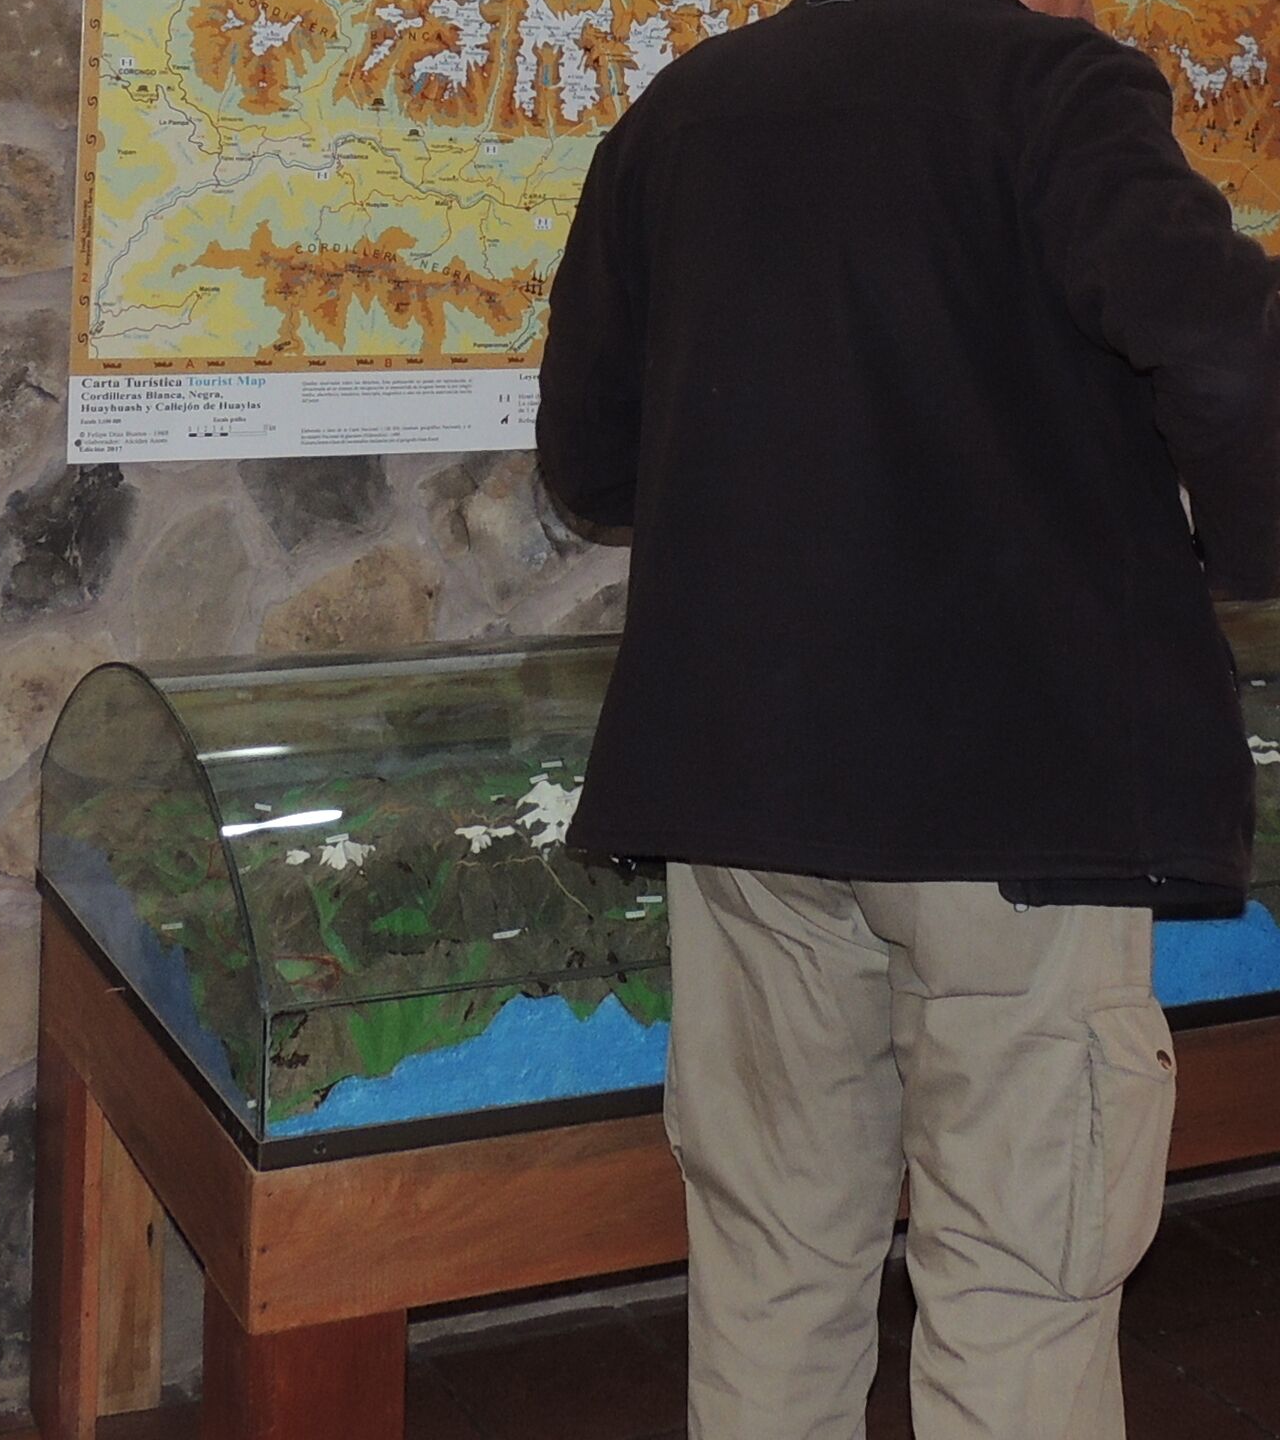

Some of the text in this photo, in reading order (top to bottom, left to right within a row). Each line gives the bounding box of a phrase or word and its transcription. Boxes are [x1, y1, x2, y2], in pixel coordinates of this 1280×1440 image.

[118, 68, 157, 76] CORONGO
[295, 243, 472, 283] CORDILLERA NEGRA
[81, 376, 267, 389] Carta Turística Tourist Map
[81, 389, 224, 402] Cordilleras Blanca, Negra,
[80, 400, 262, 415] Huayhuash y Callejón de Huaylas
